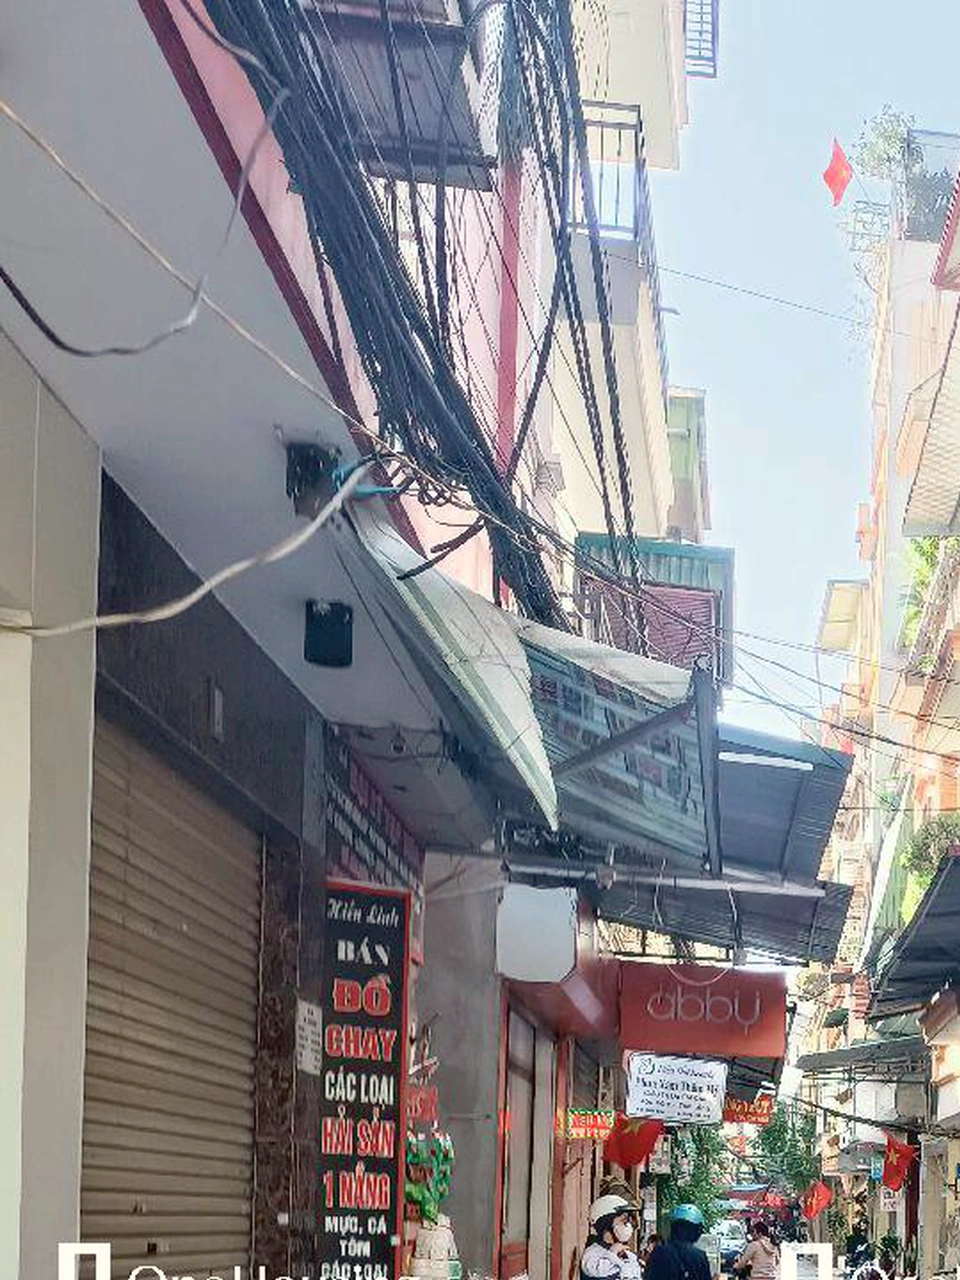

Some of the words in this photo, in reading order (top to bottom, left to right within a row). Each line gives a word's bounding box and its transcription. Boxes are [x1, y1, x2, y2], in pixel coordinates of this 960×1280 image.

[336, 936, 390, 966] BÁN
[325, 1024, 398, 1062] CHAY
[324, 1064, 357, 1102] CÁC
[361, 1072, 395, 1110] LOẠI
[323, 1169, 334, 1209] 1
